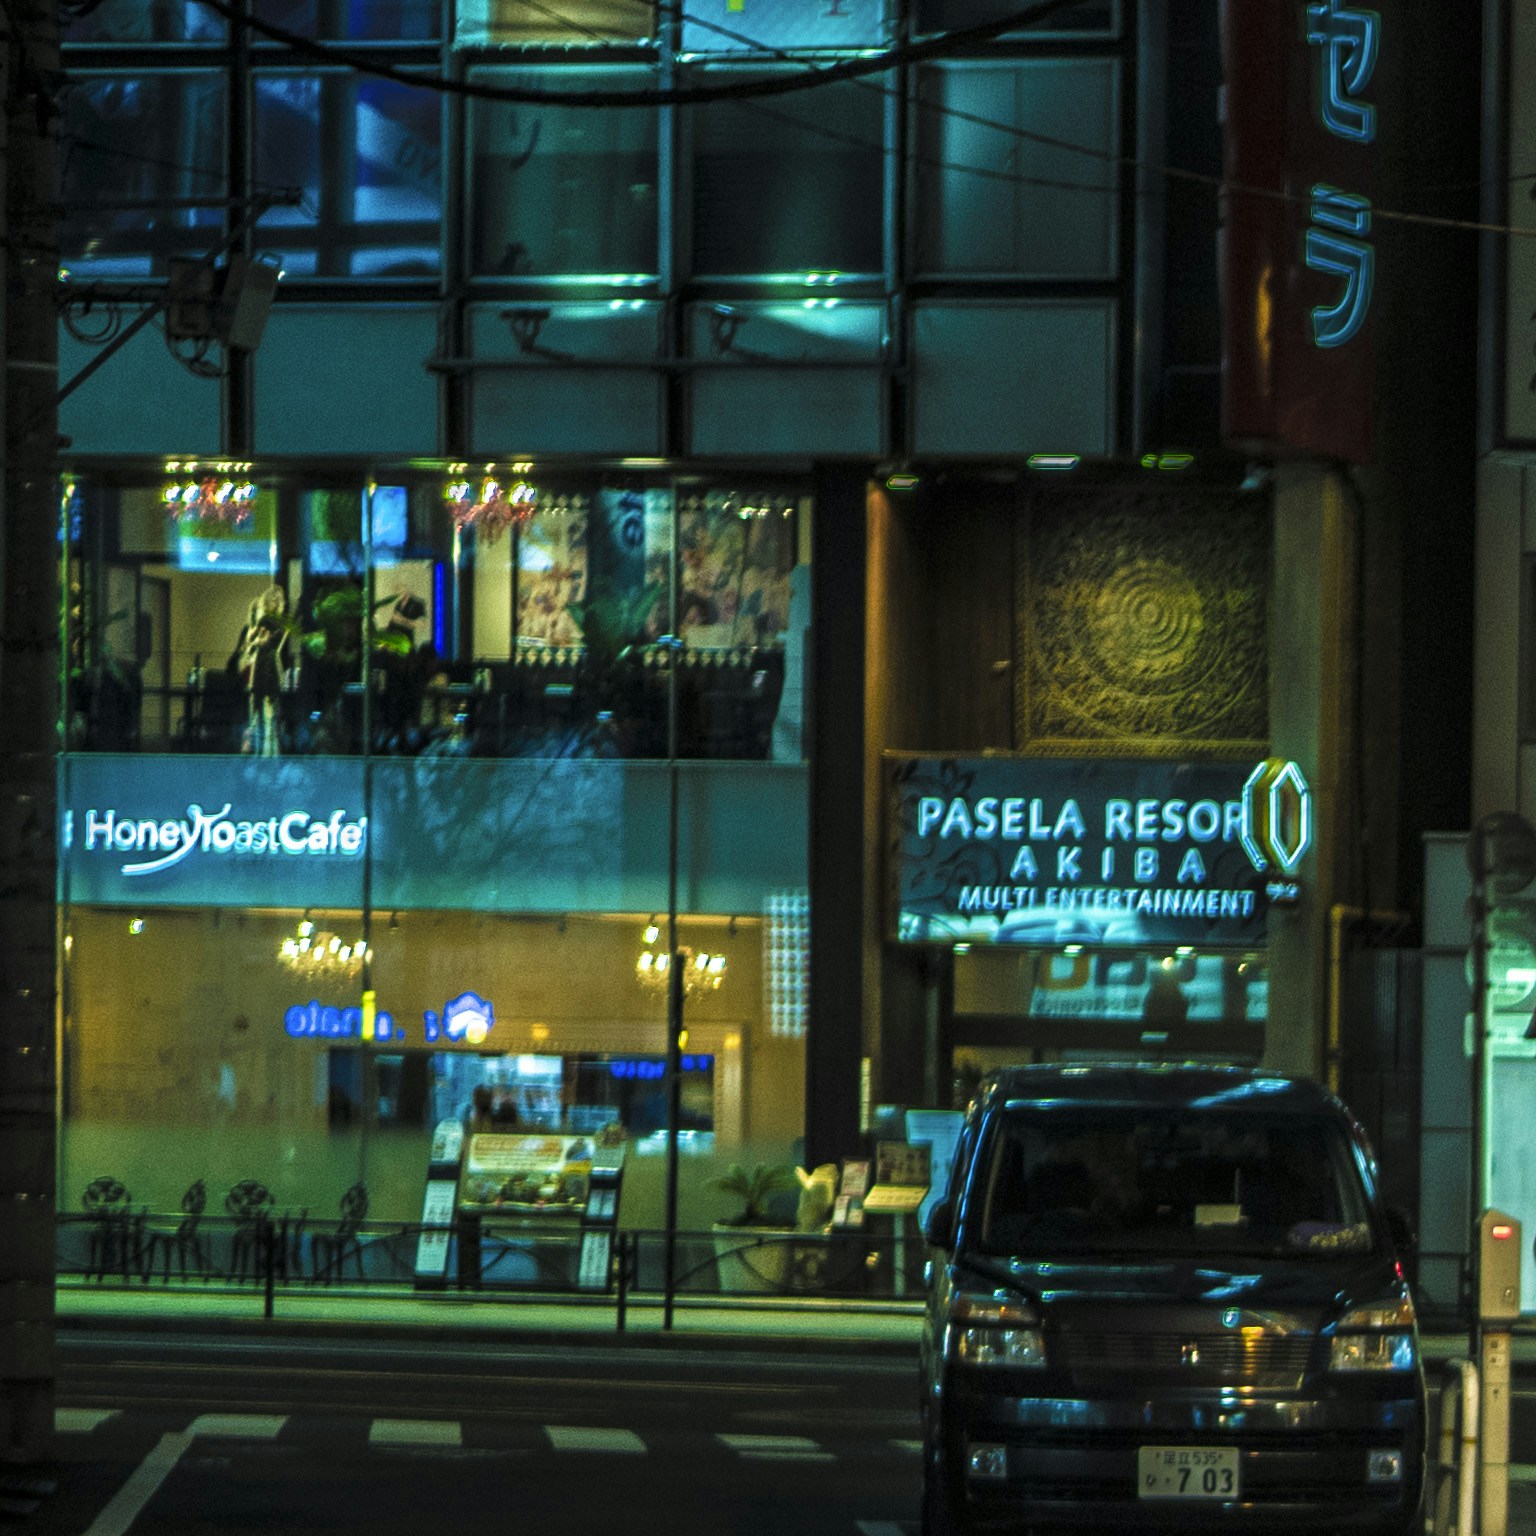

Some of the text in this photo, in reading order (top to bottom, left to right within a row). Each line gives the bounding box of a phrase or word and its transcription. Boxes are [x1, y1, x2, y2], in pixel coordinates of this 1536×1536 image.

[917, 797, 1087, 842] PASELA
[958, 886, 1038, 912] MULTI
[1046, 887, 1255, 918] ENTERTAINMENT
